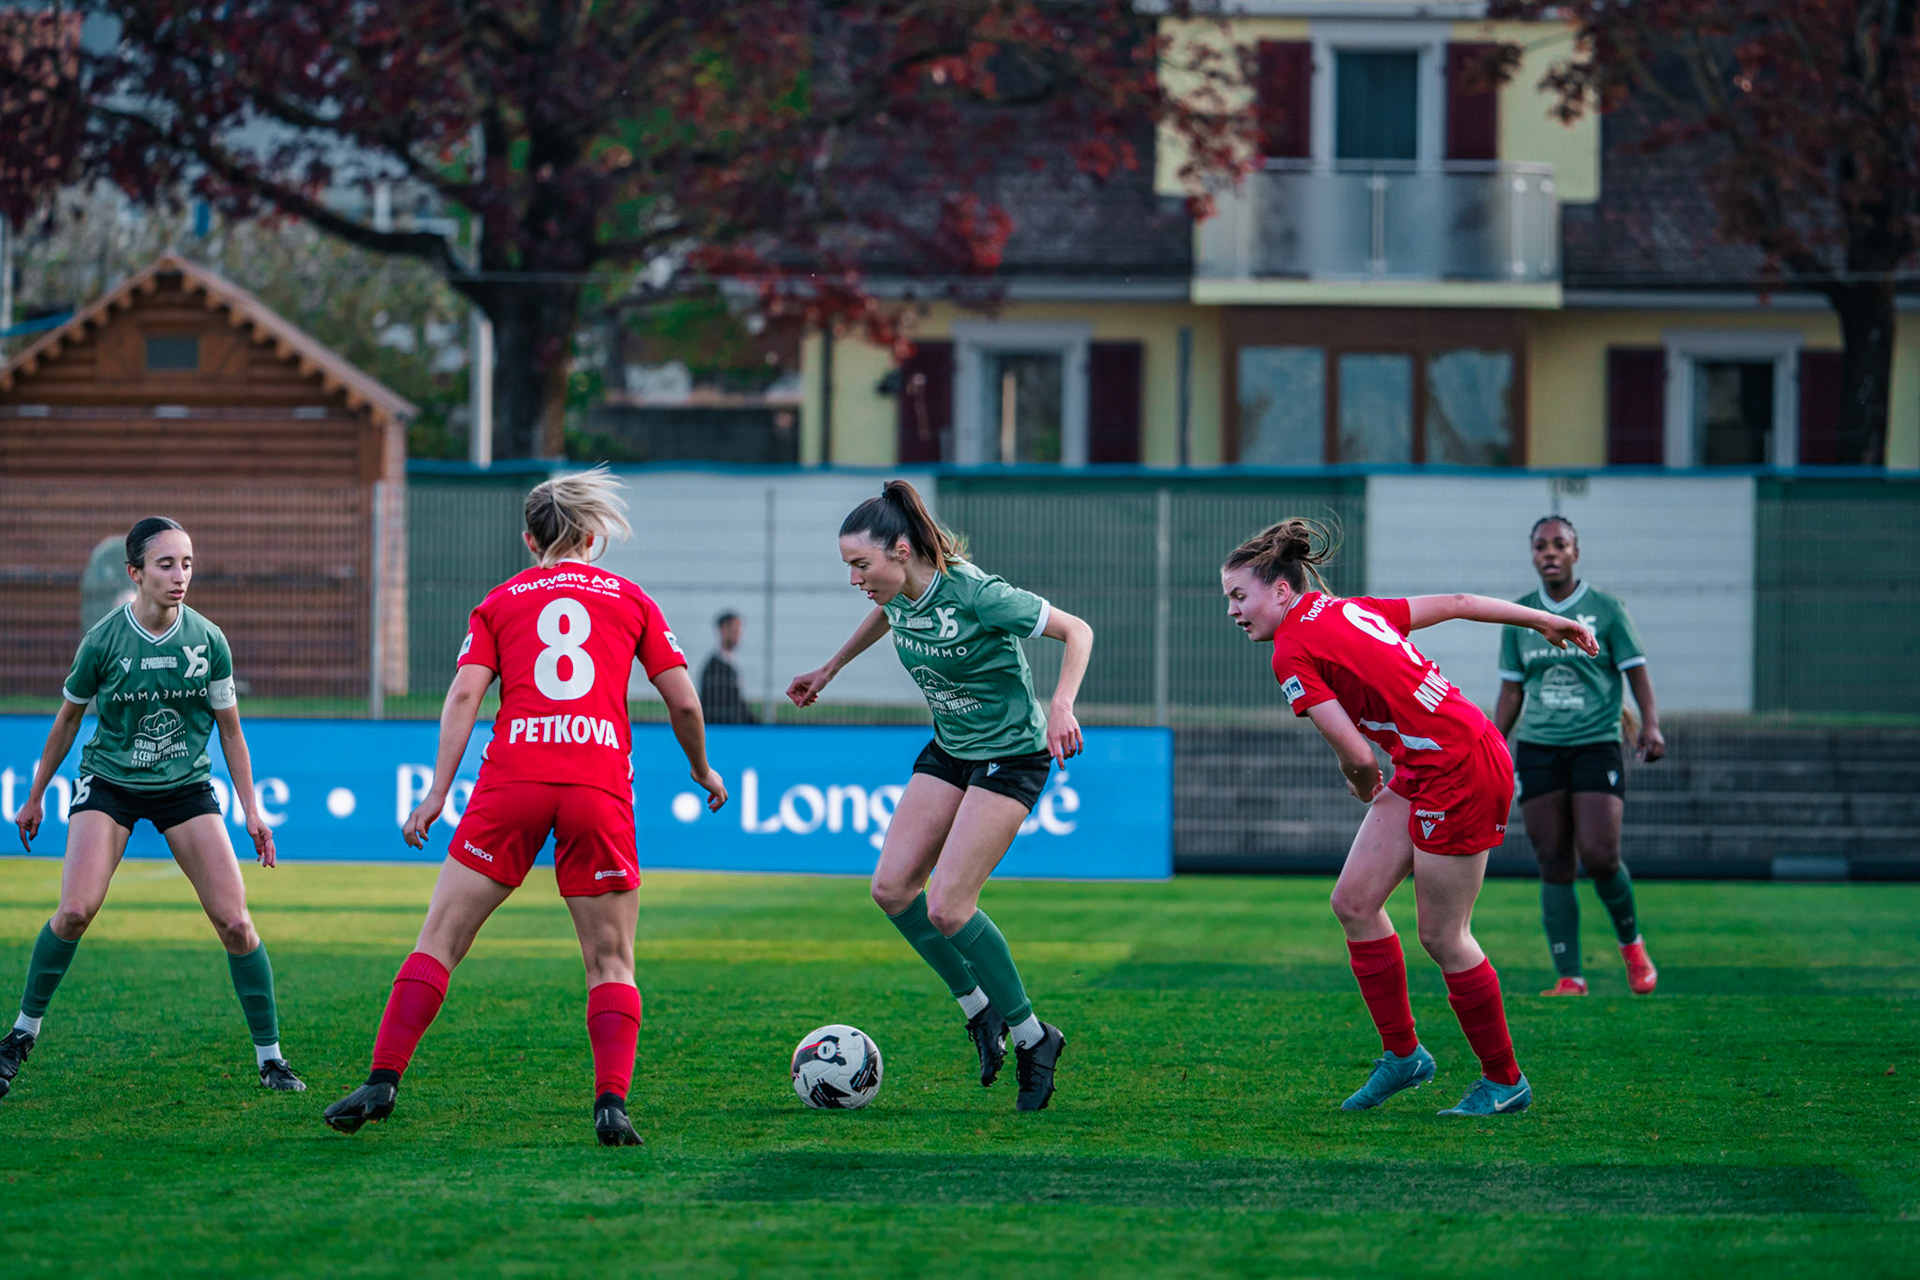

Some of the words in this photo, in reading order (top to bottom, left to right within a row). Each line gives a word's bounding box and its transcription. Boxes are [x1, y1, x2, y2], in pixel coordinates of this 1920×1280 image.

[507, 573, 588, 595] Toutvent
[591, 575, 620, 587] AG
[534, 598, 595, 700] 8
[134, 739, 157, 752] GRAND
[509, 714, 620, 749] PETKOVA
